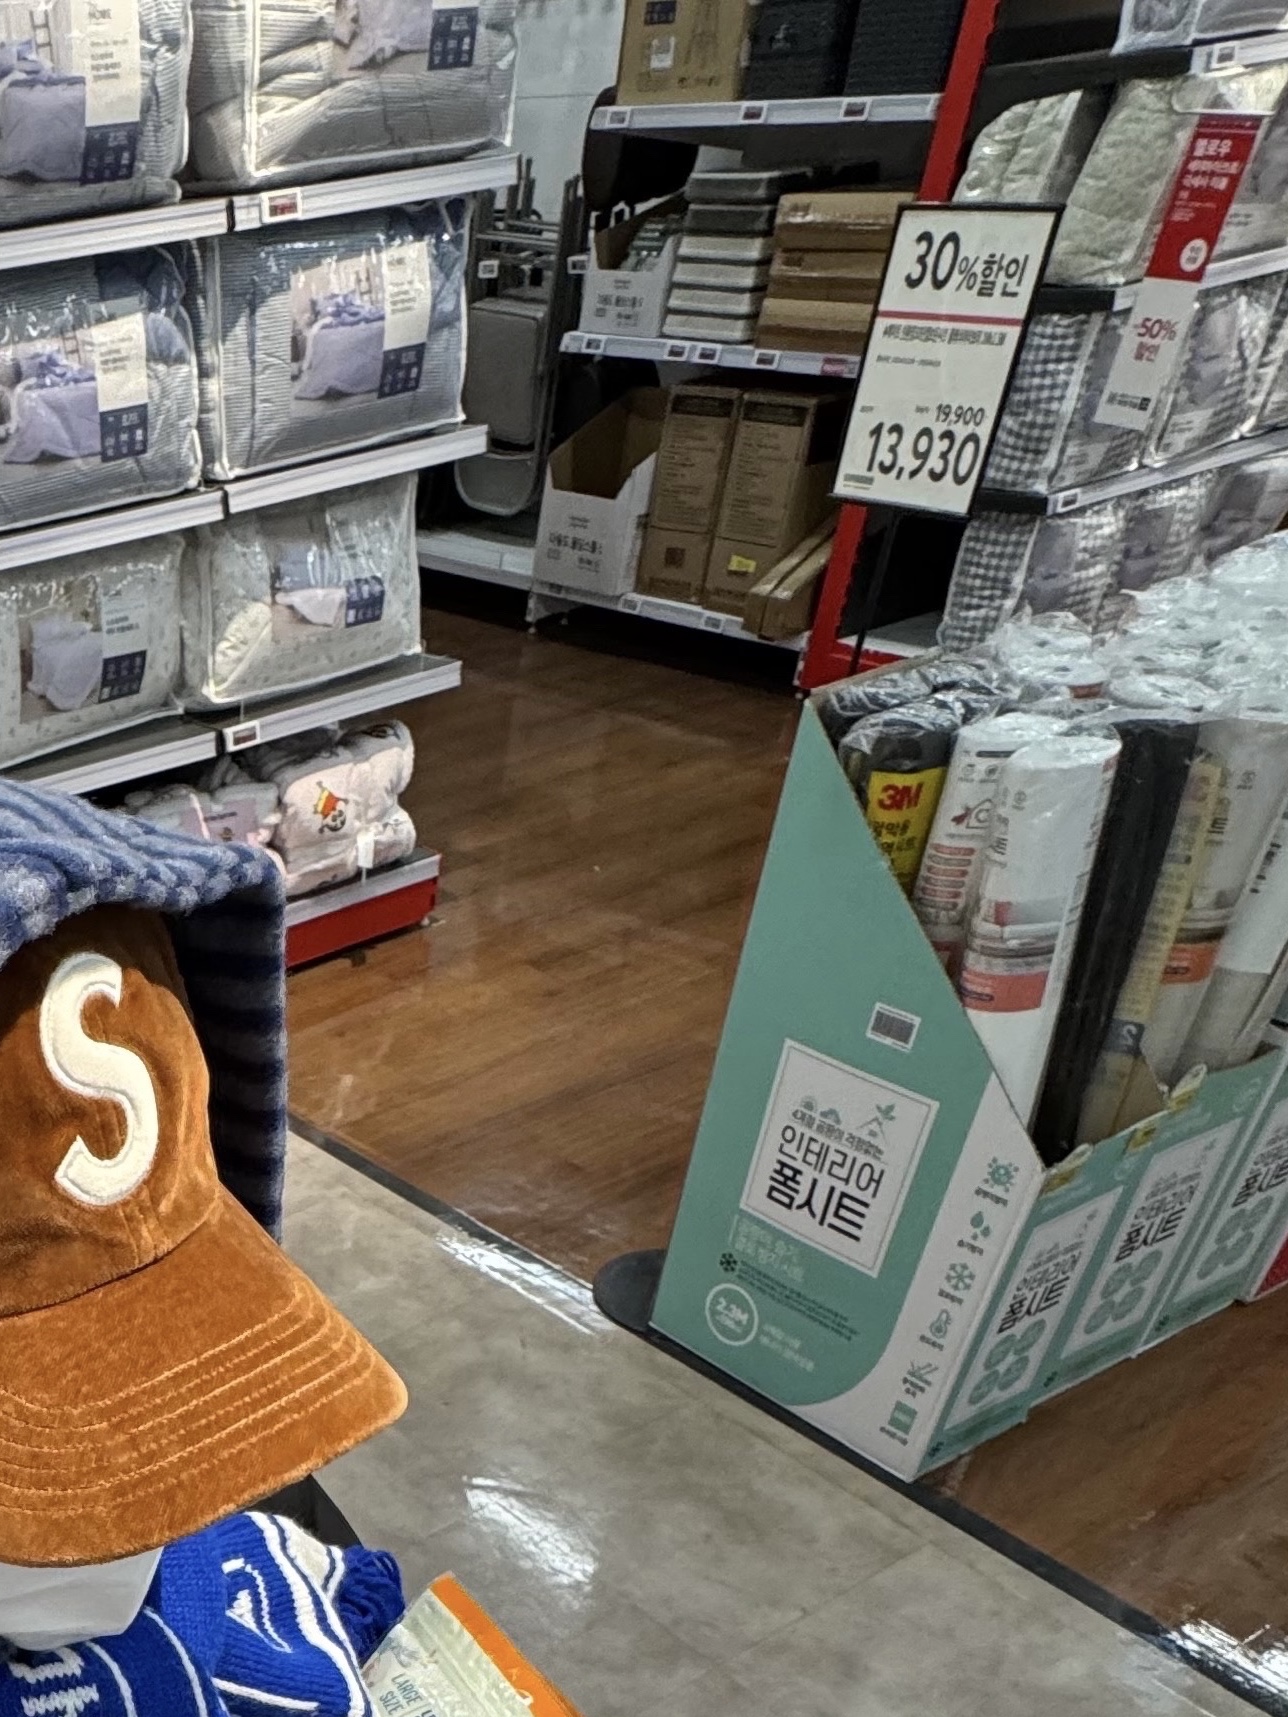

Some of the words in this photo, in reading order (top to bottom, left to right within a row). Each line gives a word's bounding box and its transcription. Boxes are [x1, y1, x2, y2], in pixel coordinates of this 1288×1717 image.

[905, 230, 1029, 298] 30%할인
[935, 402, 985, 426] 19,900
[866, 421, 981, 486] 13,930
[878, 782, 924, 811] 3M
[39, 951, 159, 1207] S
[779, 1125, 885, 1199] 인테리어
[766, 1159, 871, 1242] 폼시트
[1114, 1207, 1186, 1263] 폼시트
[997, 1275, 1070, 1334] 폼시트
[379, 1691, 404, 1716] SIZE
[392, 1673, 423, 1706] LARGE
